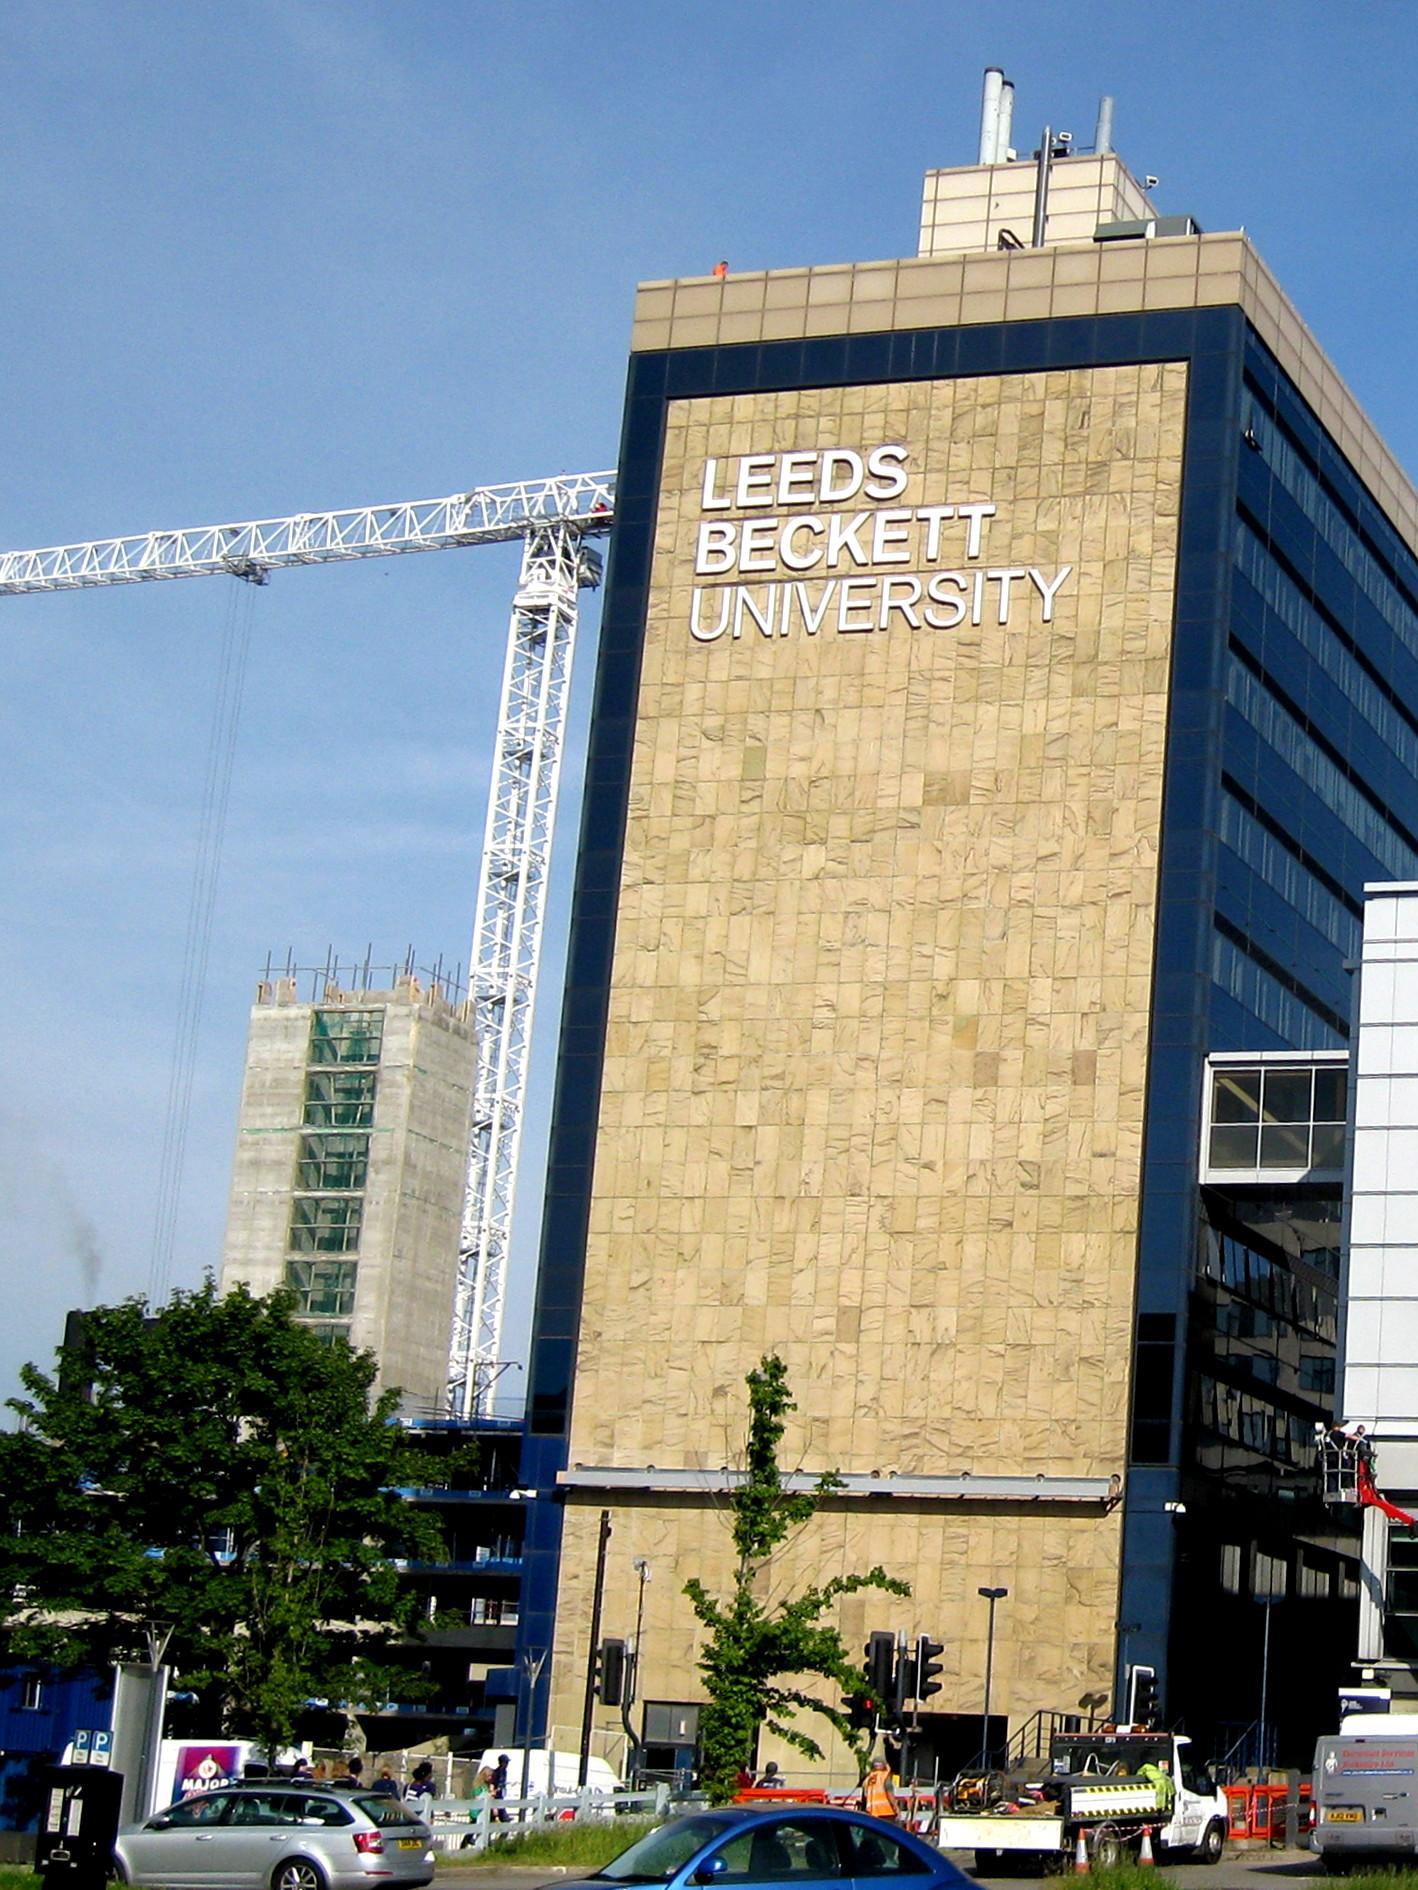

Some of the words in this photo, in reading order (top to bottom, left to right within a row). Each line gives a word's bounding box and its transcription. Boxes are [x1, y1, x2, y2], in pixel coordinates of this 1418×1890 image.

[701, 445, 909, 511] LEEDS
[695, 504, 996, 574] BECKETT
[689, 566, 1073, 642] UNIVERSITY
[77, 1732, 87, 1749] P
[96, 1733, 108, 1750] P
